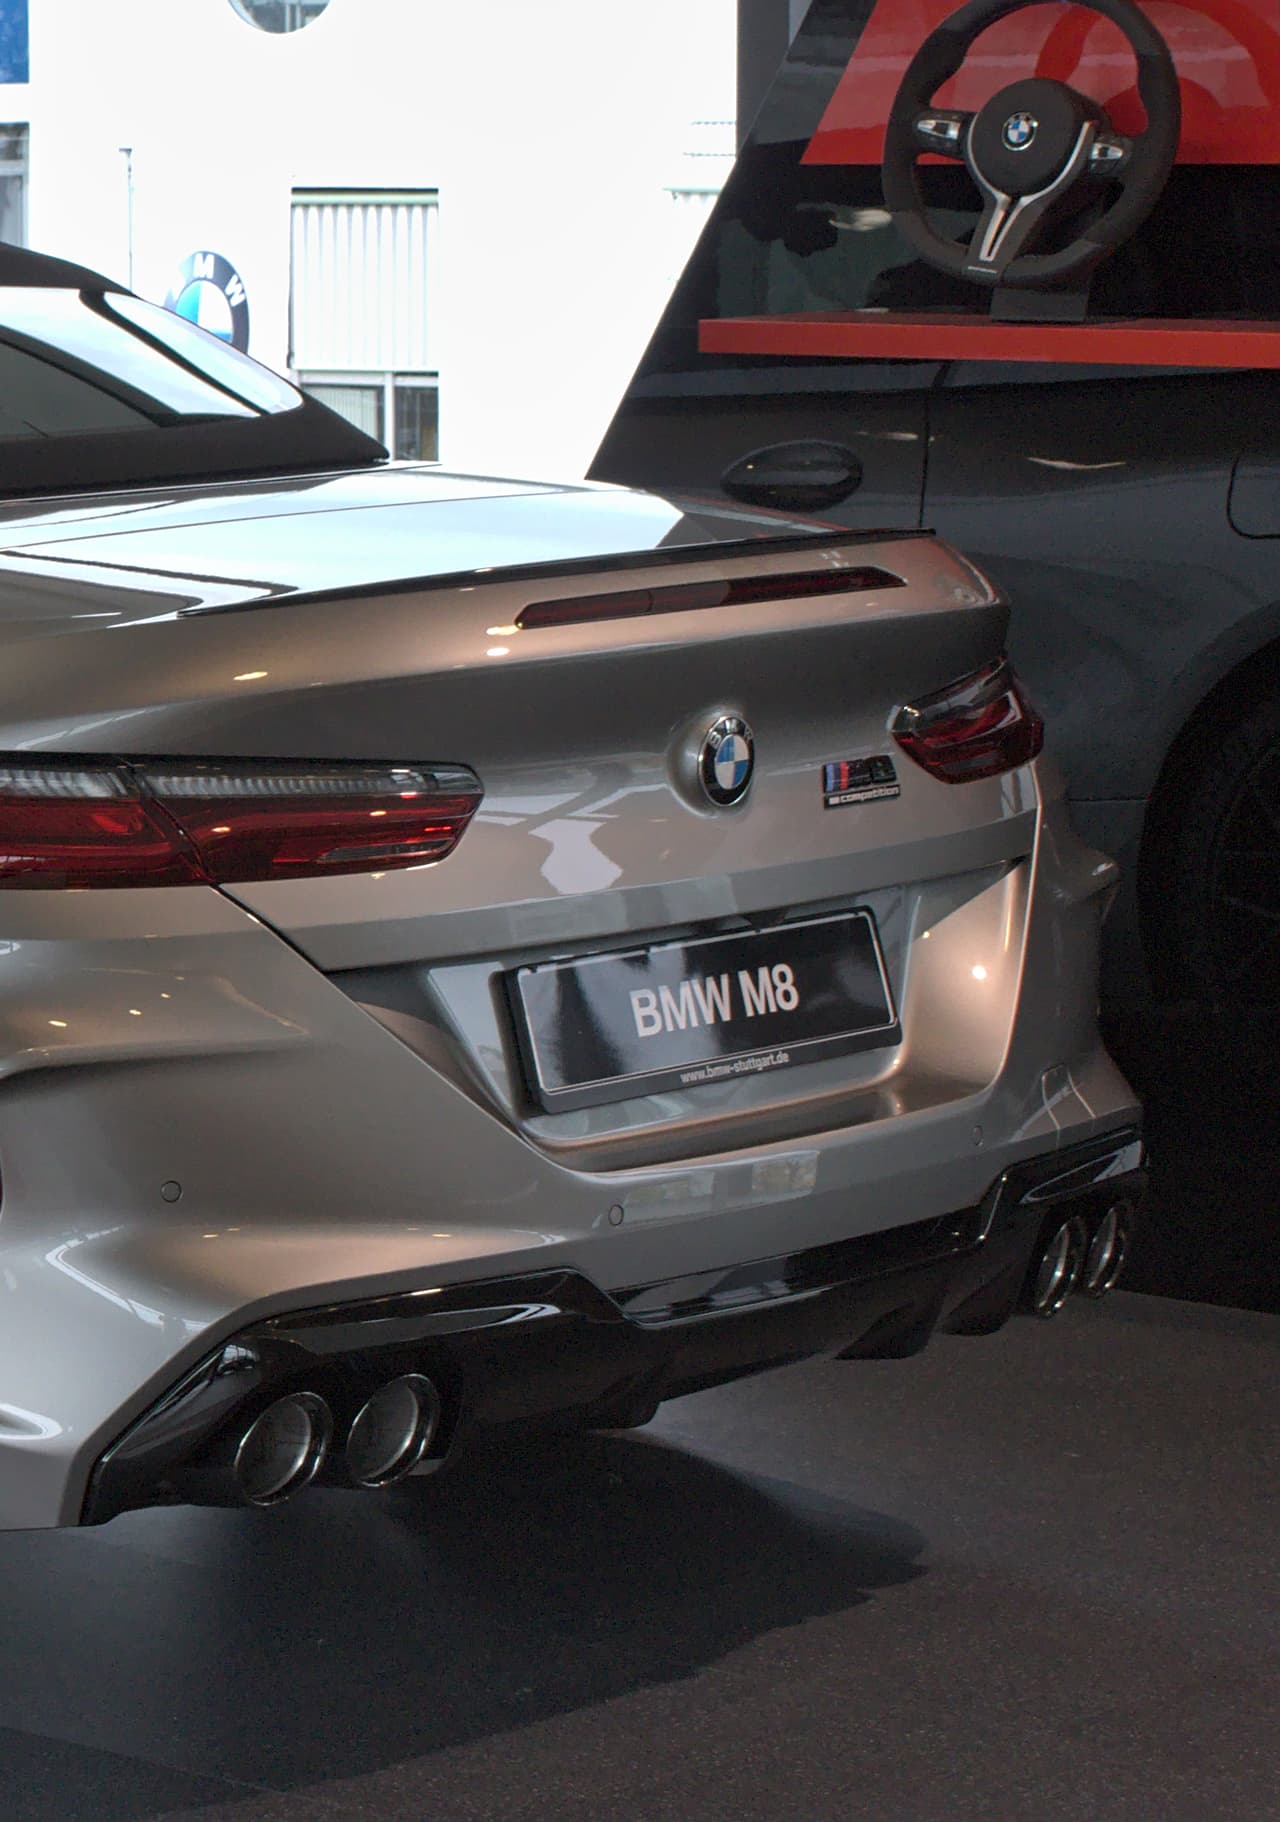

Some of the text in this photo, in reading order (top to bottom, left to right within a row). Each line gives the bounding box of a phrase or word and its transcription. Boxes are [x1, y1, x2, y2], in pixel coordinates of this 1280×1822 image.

[629, 963, 800, 1038] BMW M8
[680, 1051, 790, 1084] www.bmw-stuttgart.de
